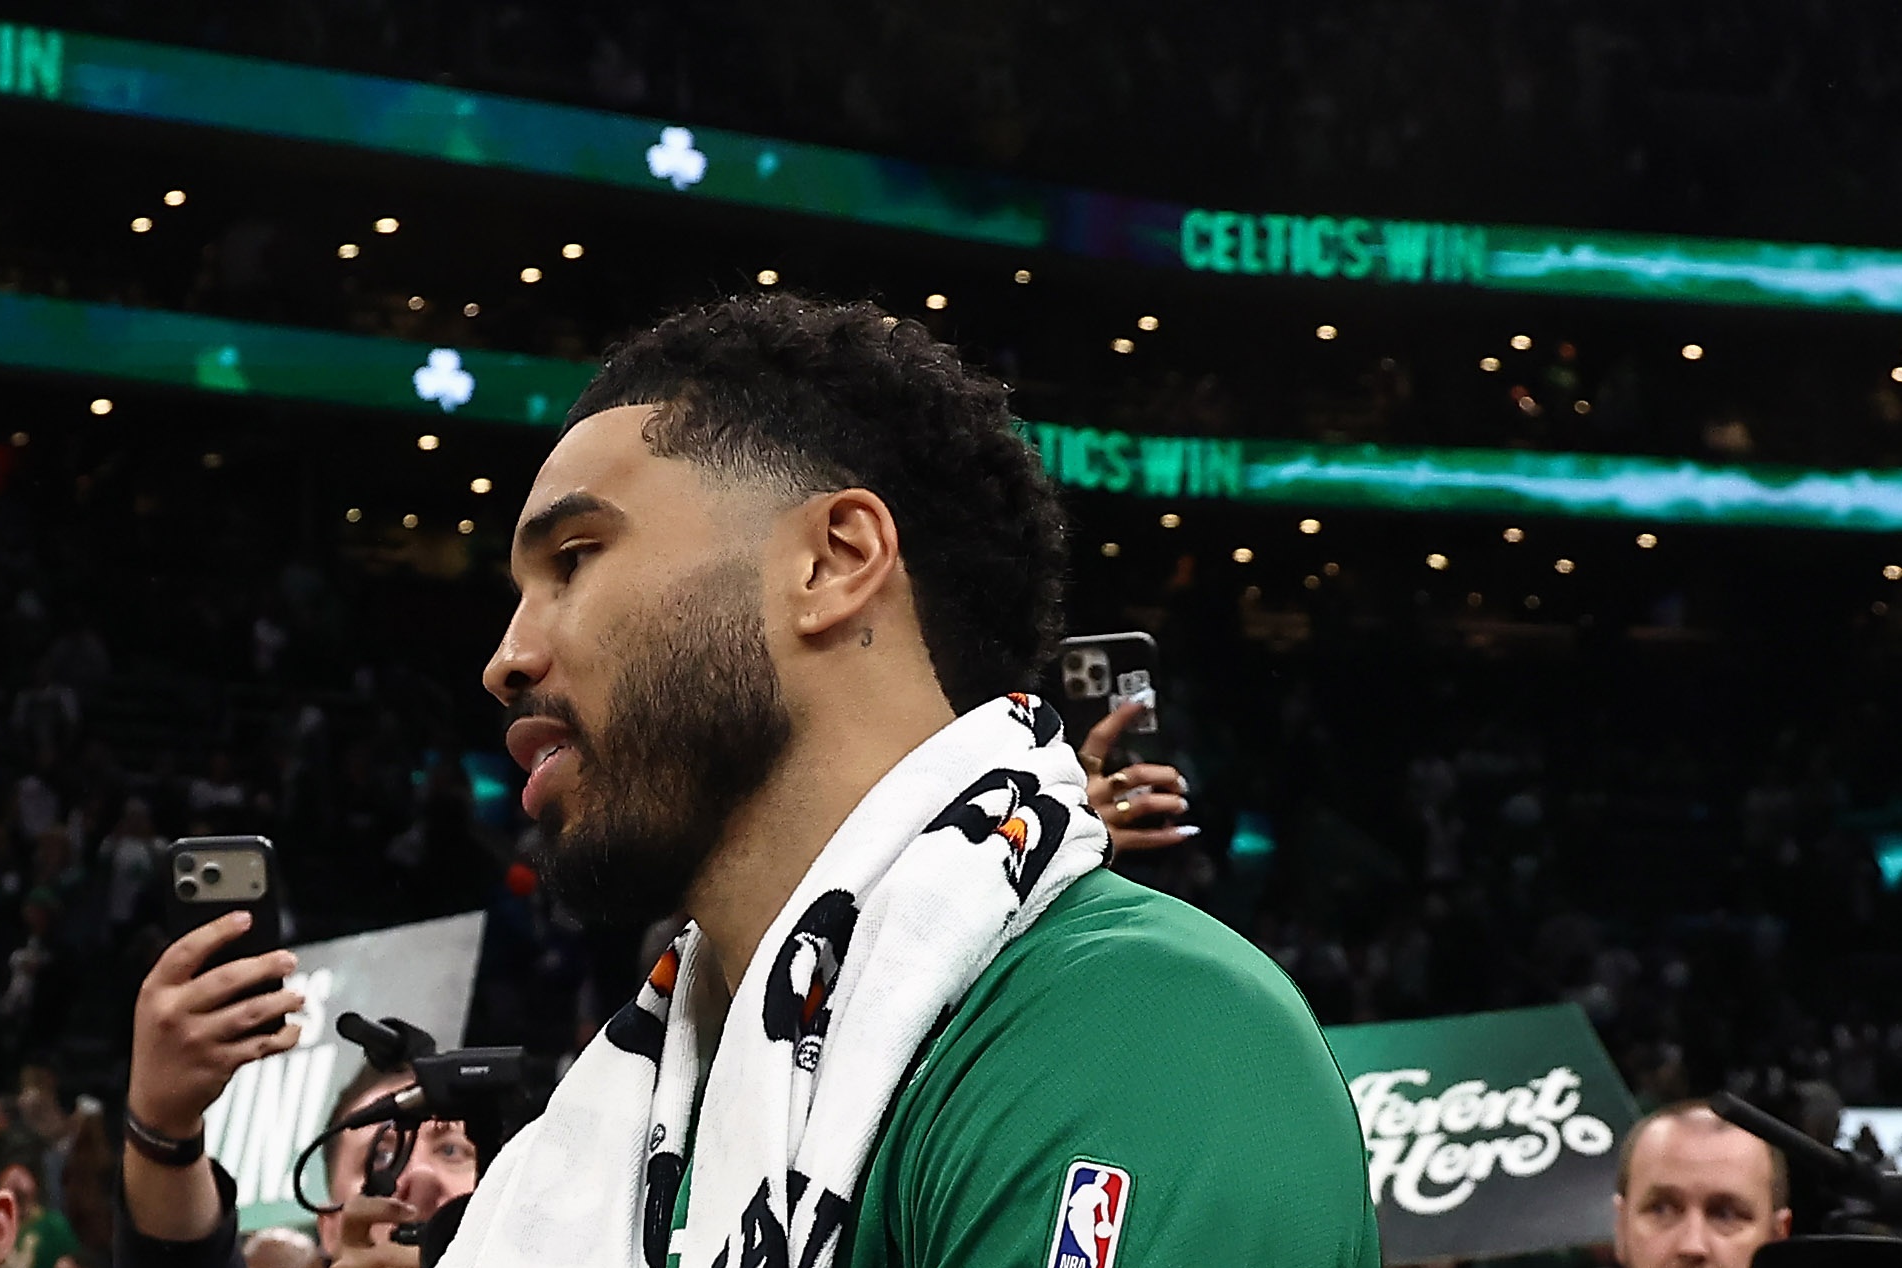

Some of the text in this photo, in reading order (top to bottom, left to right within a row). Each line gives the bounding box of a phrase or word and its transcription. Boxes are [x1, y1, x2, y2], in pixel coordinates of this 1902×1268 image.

[1181, 208, 1486, 284] CELTICS WIN
[1020, 420, 1243, 498] TICS WIN
